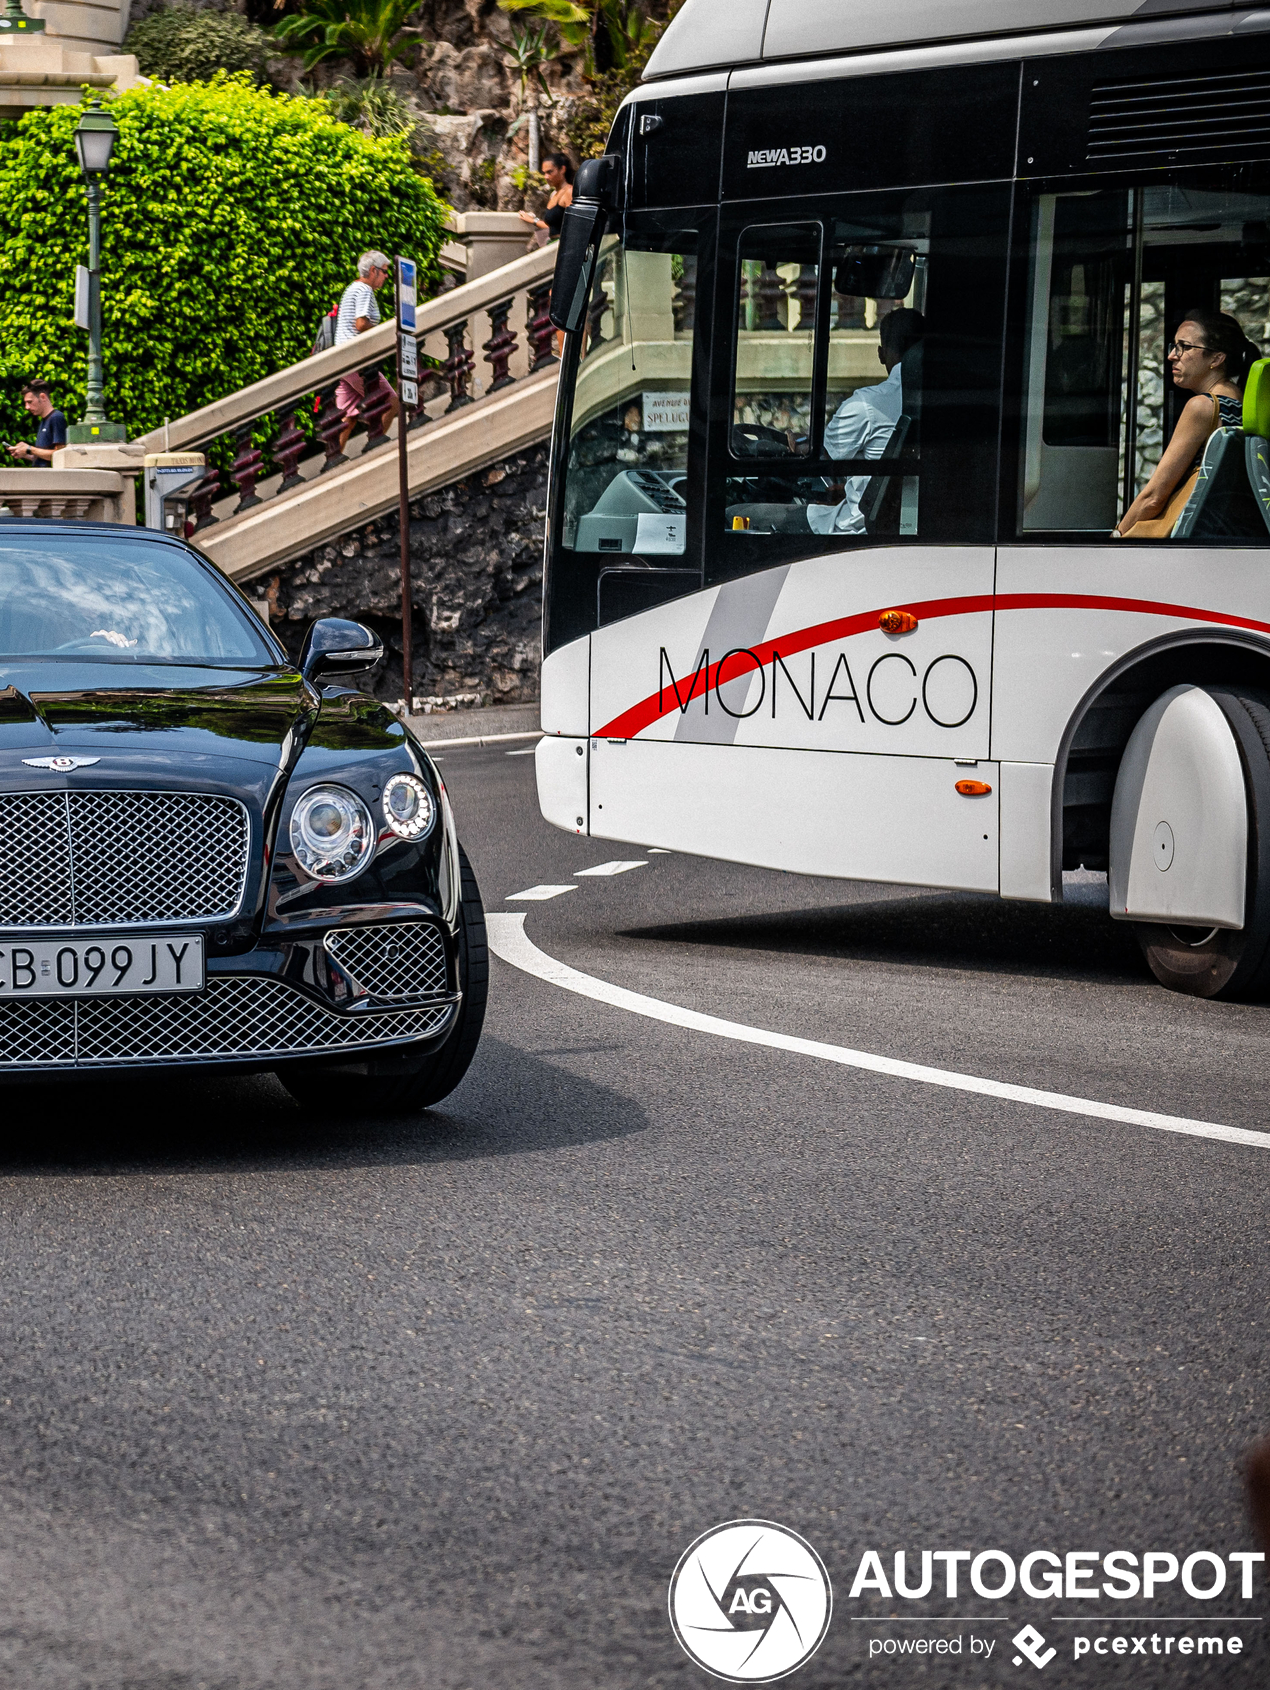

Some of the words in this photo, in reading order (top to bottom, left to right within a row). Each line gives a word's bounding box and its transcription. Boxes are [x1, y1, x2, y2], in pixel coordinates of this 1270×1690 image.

[658, 646, 979, 728] MONACO
[56, 945, 133, 987] 099
[141, 943, 190, 985] JY
